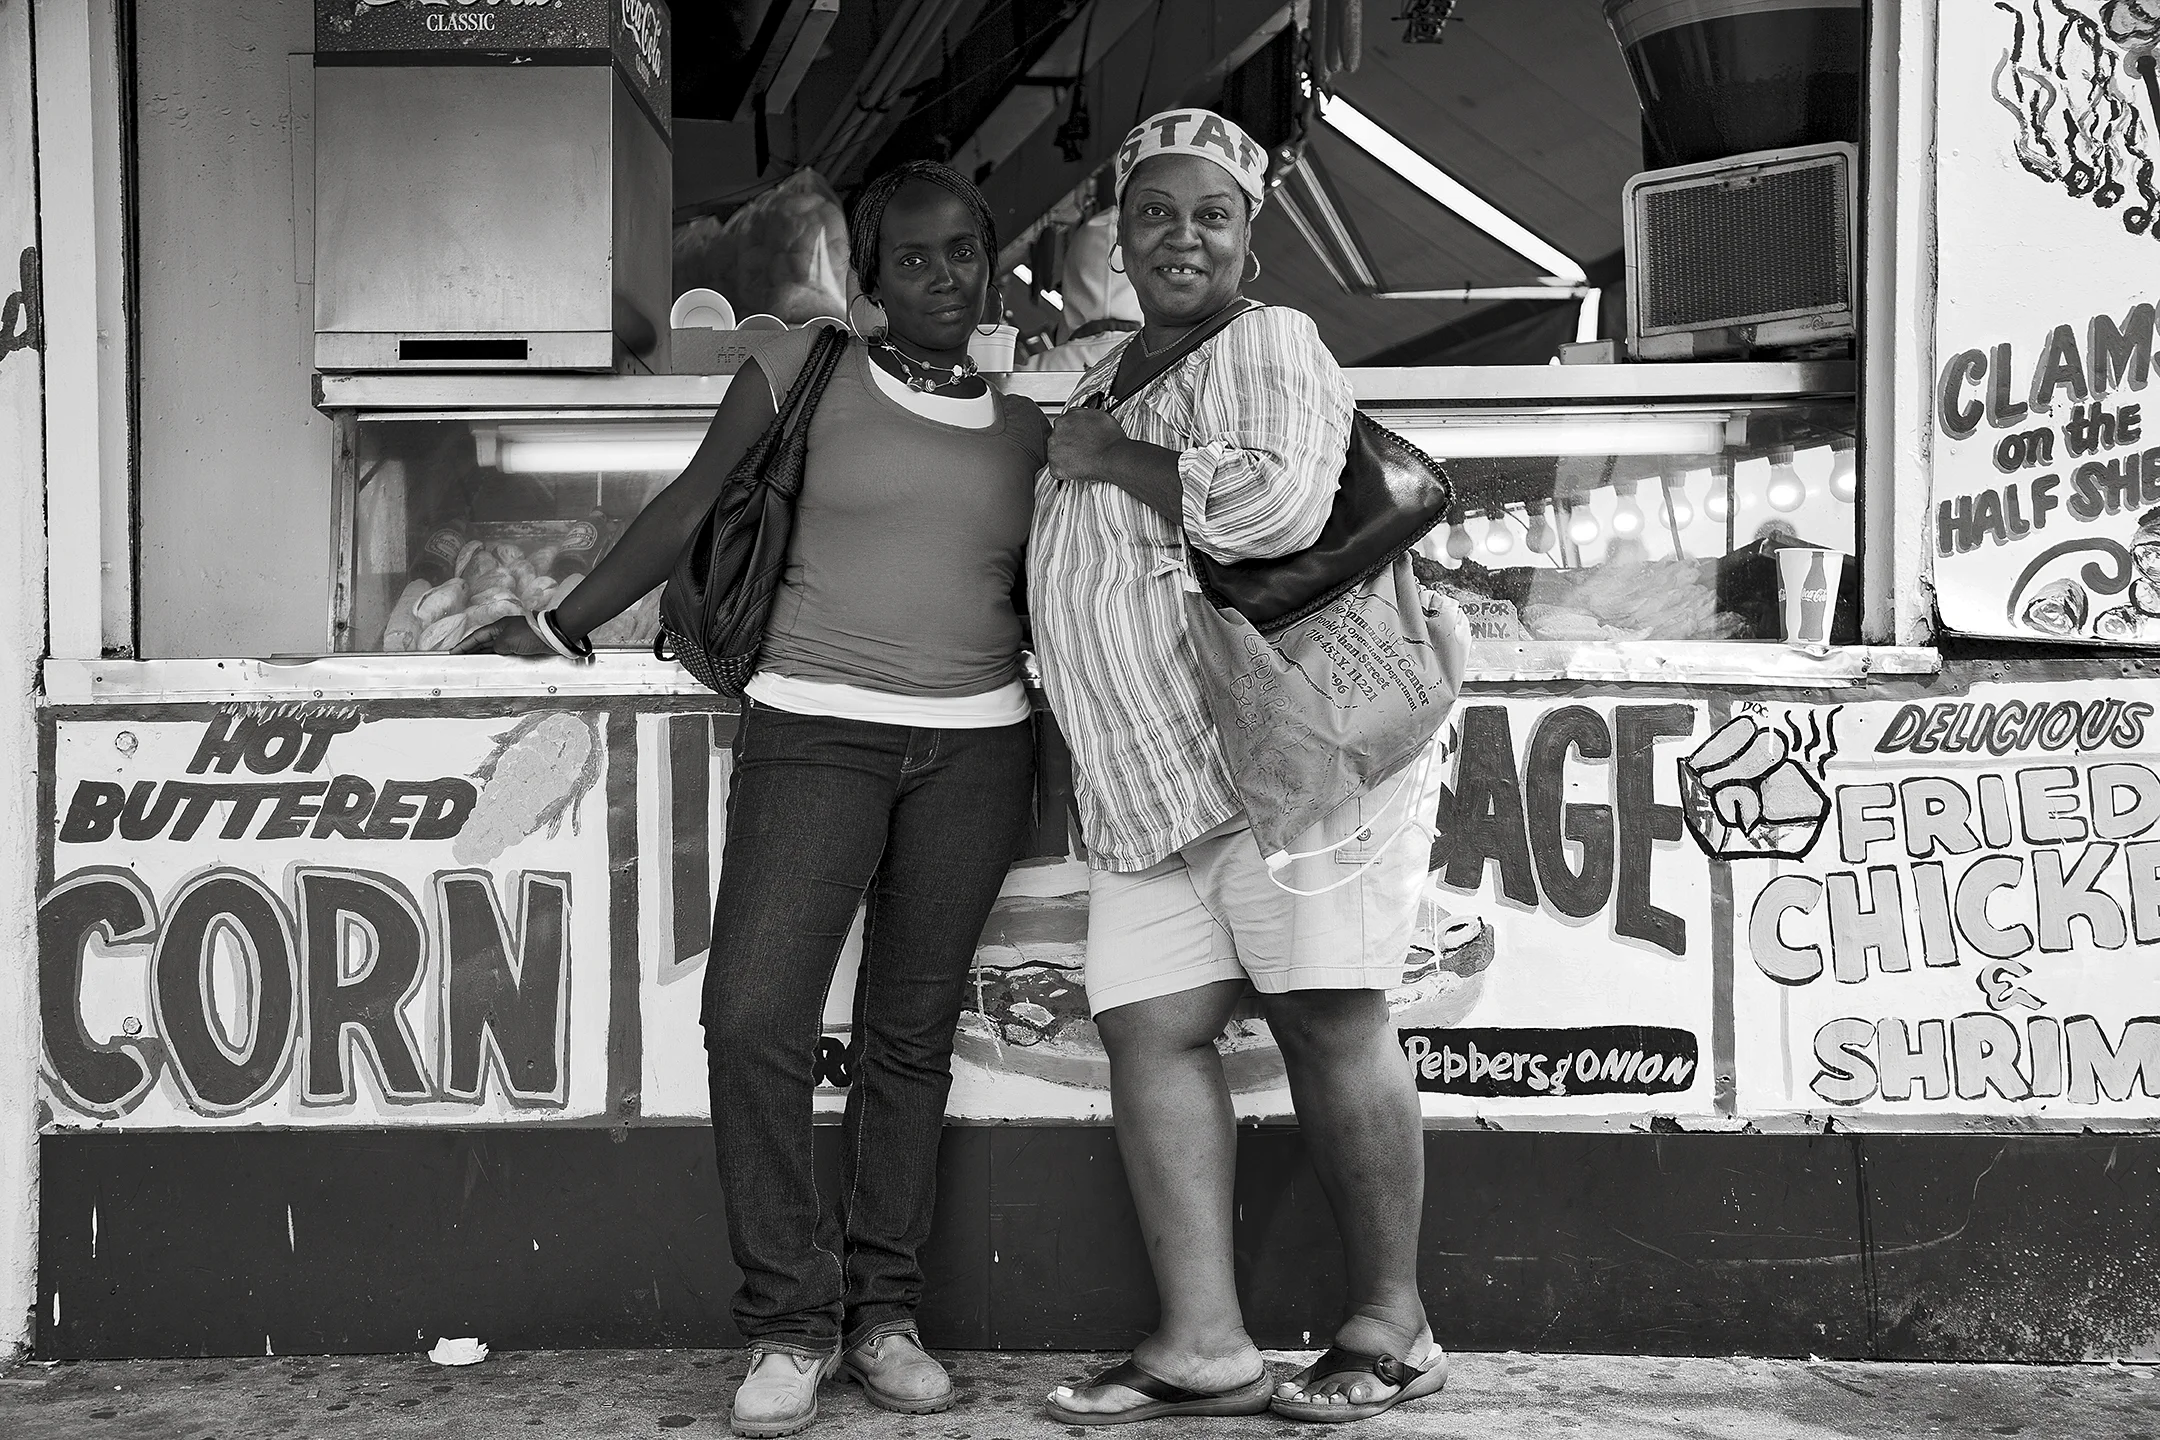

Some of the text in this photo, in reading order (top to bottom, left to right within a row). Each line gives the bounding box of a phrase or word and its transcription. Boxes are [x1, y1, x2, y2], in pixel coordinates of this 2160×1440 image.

[426, 13, 495, 32] CLASSIC
[1937, 300, 2160, 441] CLAM
[1993, 427, 2054, 474] on
[1937, 446, 2160, 557] HALF SHE
[1461, 601, 1509, 616] OD FOR
[1470, 621, 1510, 639] NLY.
[1346, 667, 1379, 703] 11221
[1347, 626, 1384, 665] Operations
[1382, 663, 1418, 712] Department
[1359, 653, 1391, 691] Street
[1397, 657, 1430, 706] Center
[186, 708, 364, 775] HOT
[1875, 699, 2153, 755] DELICIOUS
[58, 776, 478, 843] BUTTERED
[1430, 704, 1697, 962] AGE
[1835, 763, 2160, 863] FRIED
[38, 865, 574, 1118] CORN
[1976, 959, 2047, 1011] &
[1575, 1048, 1694, 1085] ONION
[1809, 1012, 2160, 1104] SHRIM
